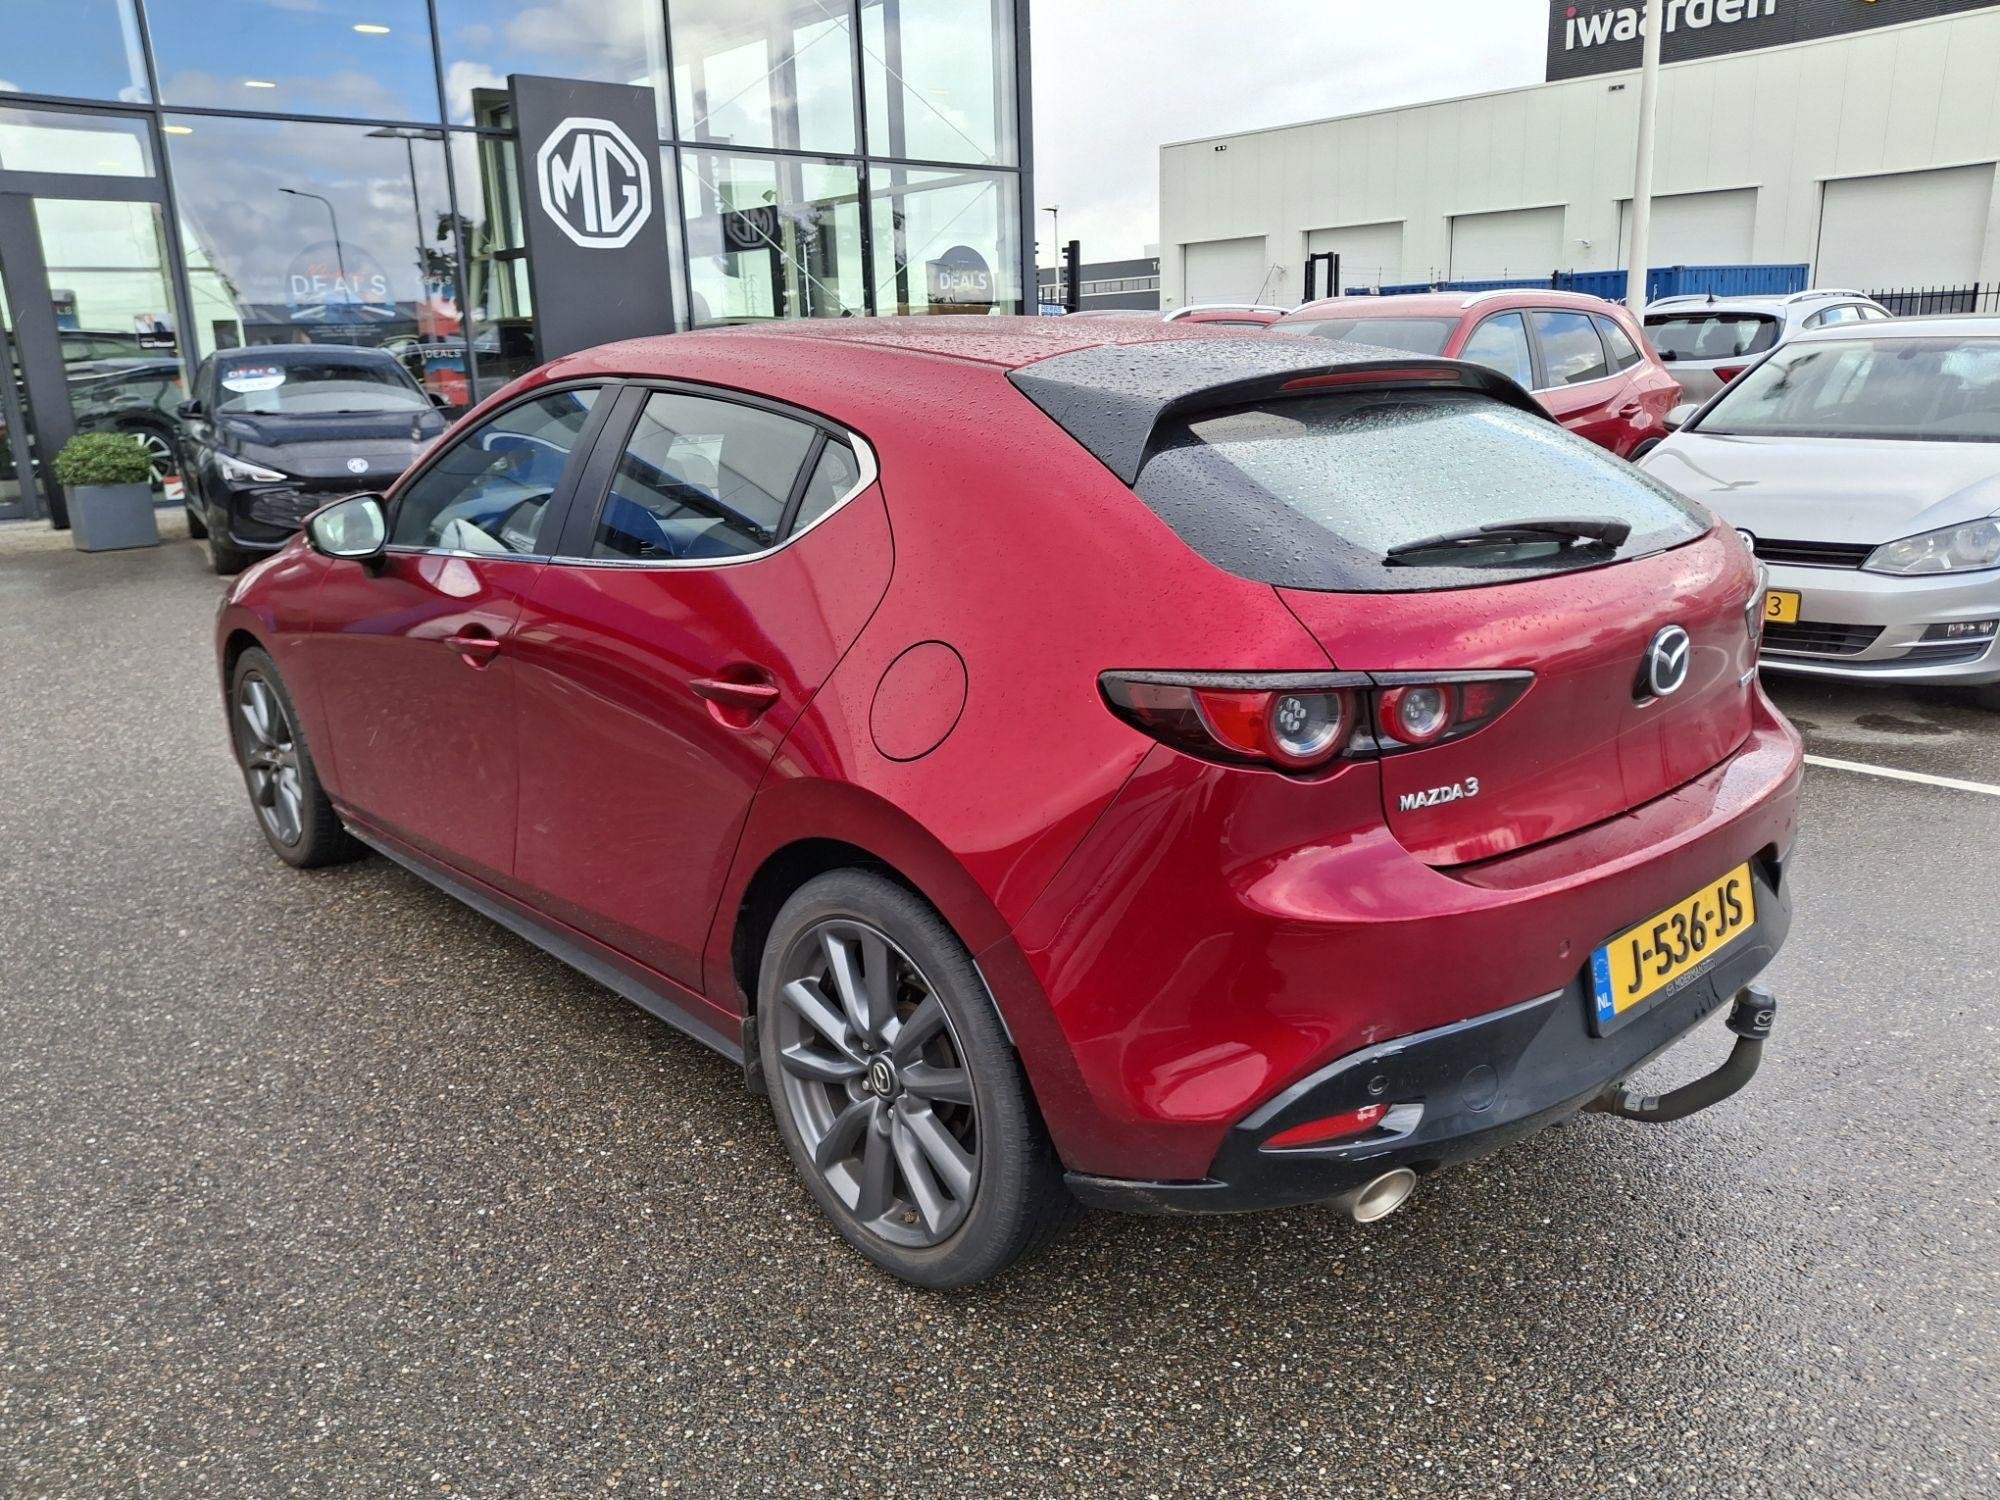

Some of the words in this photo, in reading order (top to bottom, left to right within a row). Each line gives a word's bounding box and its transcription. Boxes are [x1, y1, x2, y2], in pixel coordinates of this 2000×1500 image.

[550, 133, 639, 233] MG
[939, 271, 987, 290] DEALS
[1628, 879, 1743, 994] J-536-JS
[1597, 992, 1612, 1011] NL
